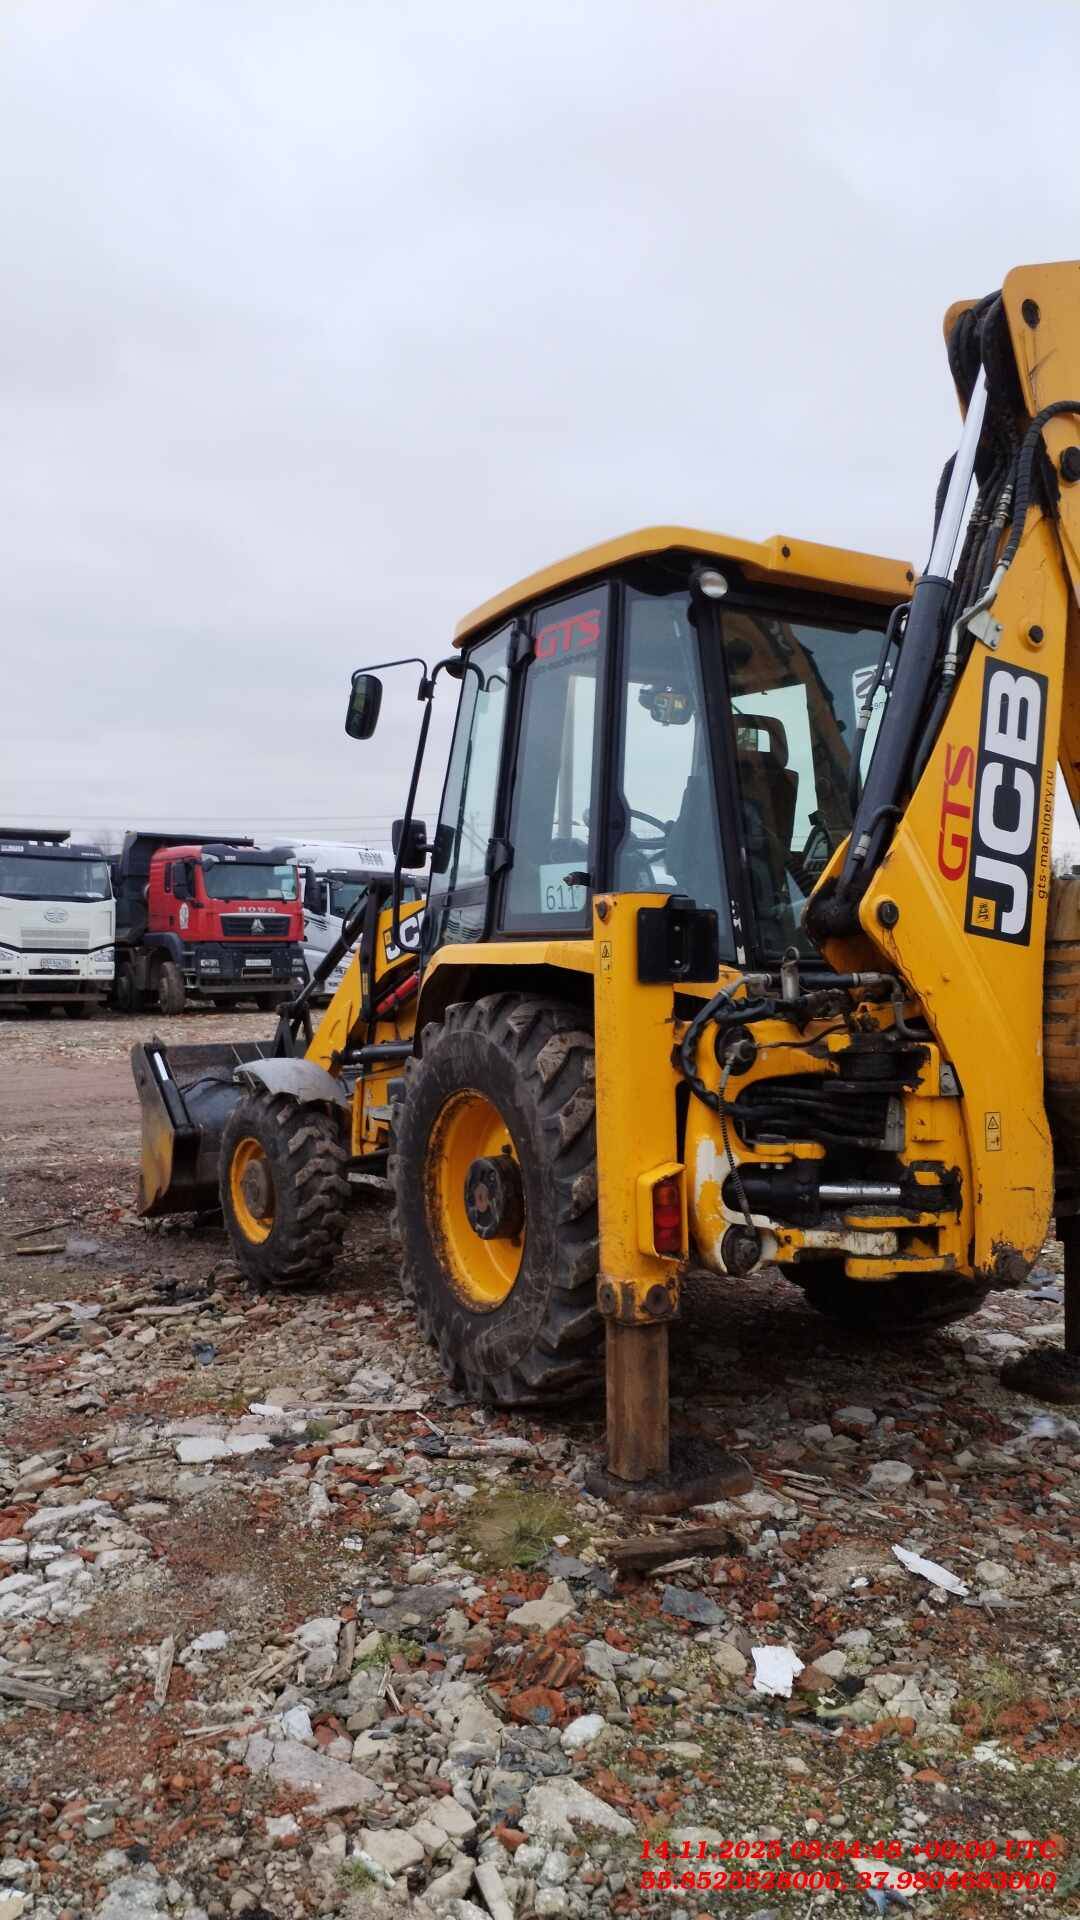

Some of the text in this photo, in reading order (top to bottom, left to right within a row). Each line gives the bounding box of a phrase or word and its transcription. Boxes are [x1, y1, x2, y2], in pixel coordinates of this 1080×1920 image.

[535, 608, 605, 659] GTS
[938, 742, 976, 881] GTS
[975, 670, 1042, 935] JCB
[1038, 769, 1055, 900] gts-machinery.ru
[386, 911, 425, 960] JC
[545, 885, 578, 911] 611
